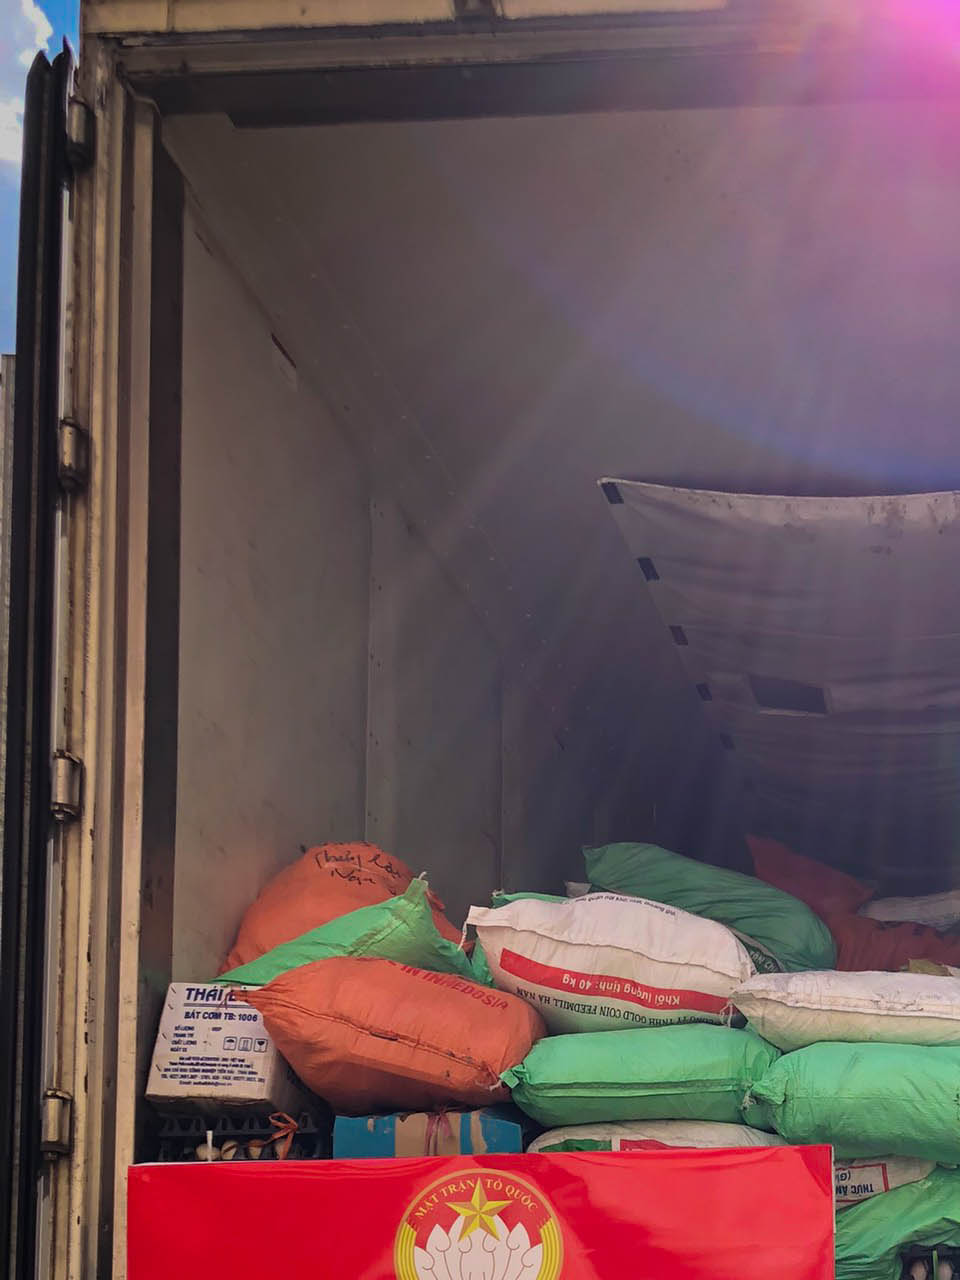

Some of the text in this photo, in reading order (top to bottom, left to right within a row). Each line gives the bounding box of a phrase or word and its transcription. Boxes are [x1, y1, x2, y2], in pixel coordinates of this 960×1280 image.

[562, 975, 576, 988] kg
[578, 981, 591, 990] 40
[185, 986, 224, 1002] THÁI
[624, 983, 652, 1004] lượng
[655, 993, 680, 1007] Khối
[553, 998, 598, 1015] FEEDMILL
[600, 1006, 621, 1018] COIN
[184, 1010, 202, 1020] BÁT
[238, 1013, 258, 1022] 1006
[623, 1010, 647, 1024] GOLD
[440, 1178, 476, 1198] TRẬN
[505, 1184, 539, 1212] QUỐC
[851, 1183, 874, 1197] THỨC
